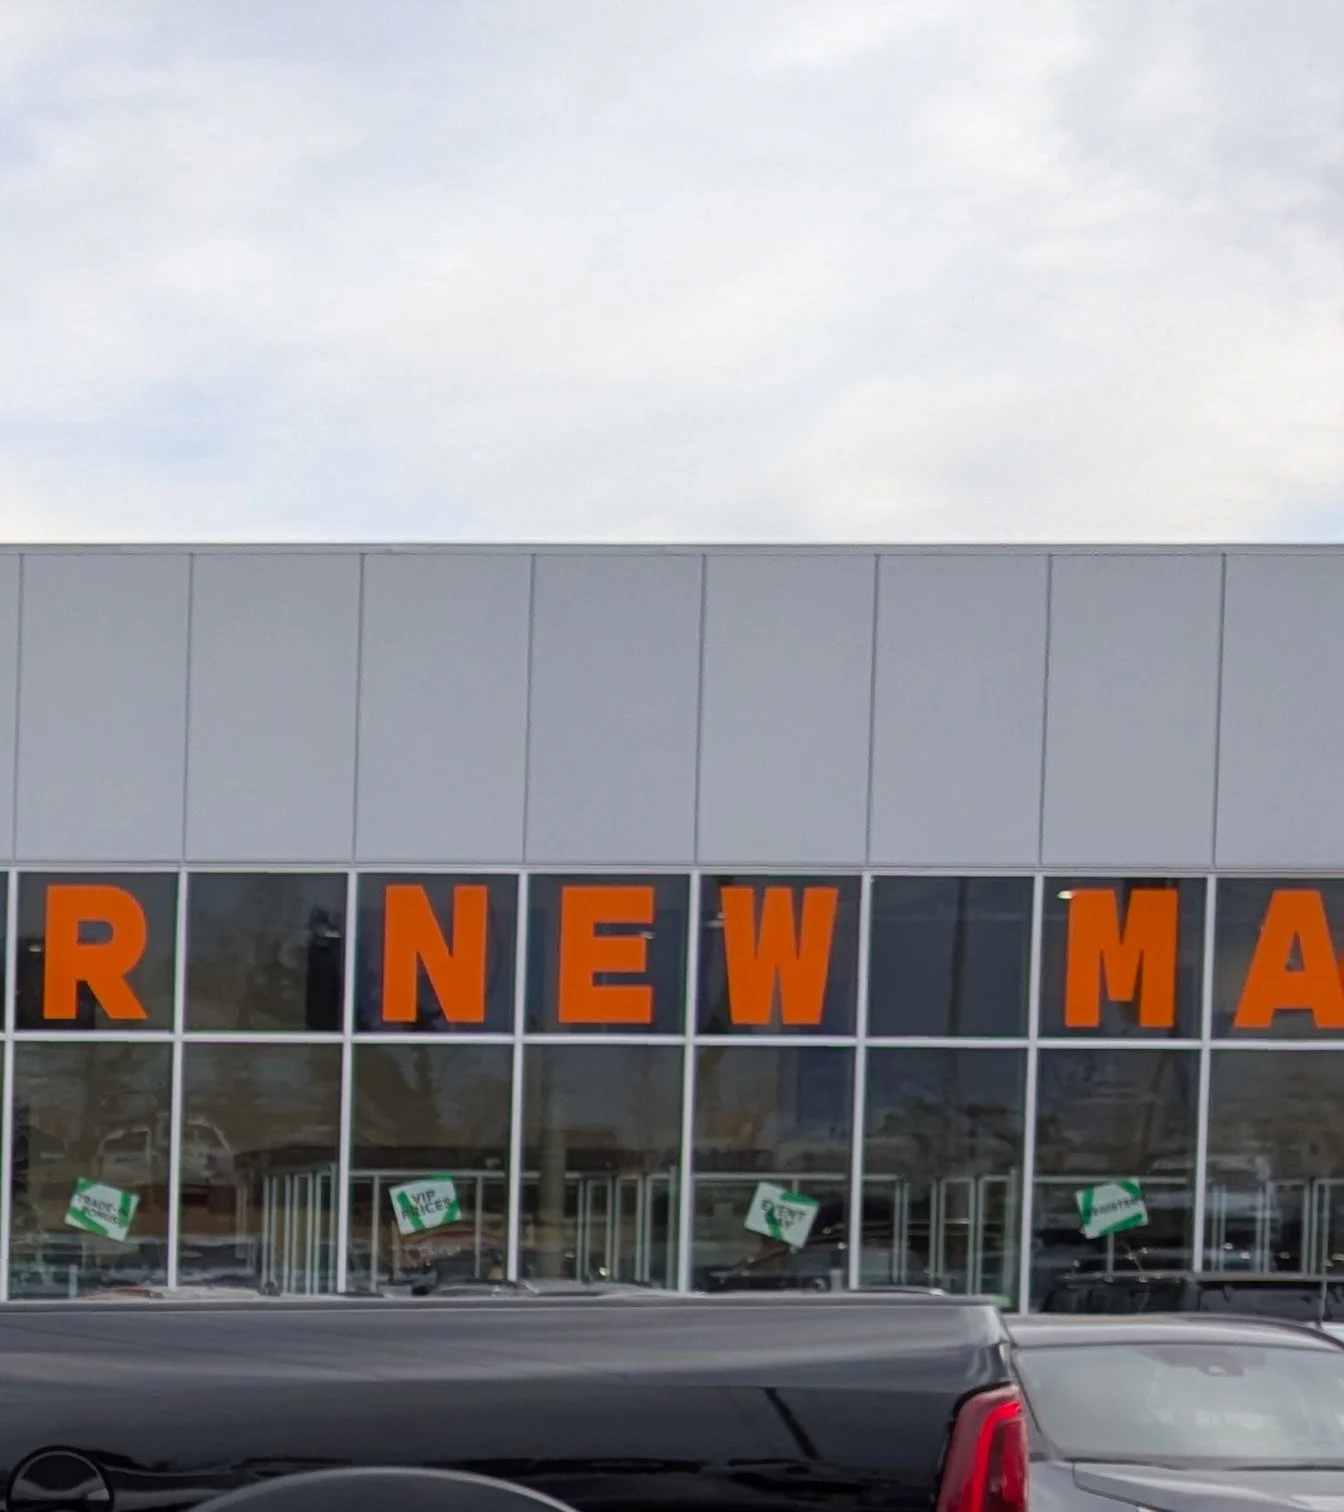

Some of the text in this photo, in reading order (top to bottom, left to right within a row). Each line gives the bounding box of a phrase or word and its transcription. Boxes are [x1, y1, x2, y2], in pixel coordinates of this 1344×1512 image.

[381, 884, 839, 1025] NEW
[1064, 888, 1344, 1028] MA
[412, 1190, 435, 1206] VIP
